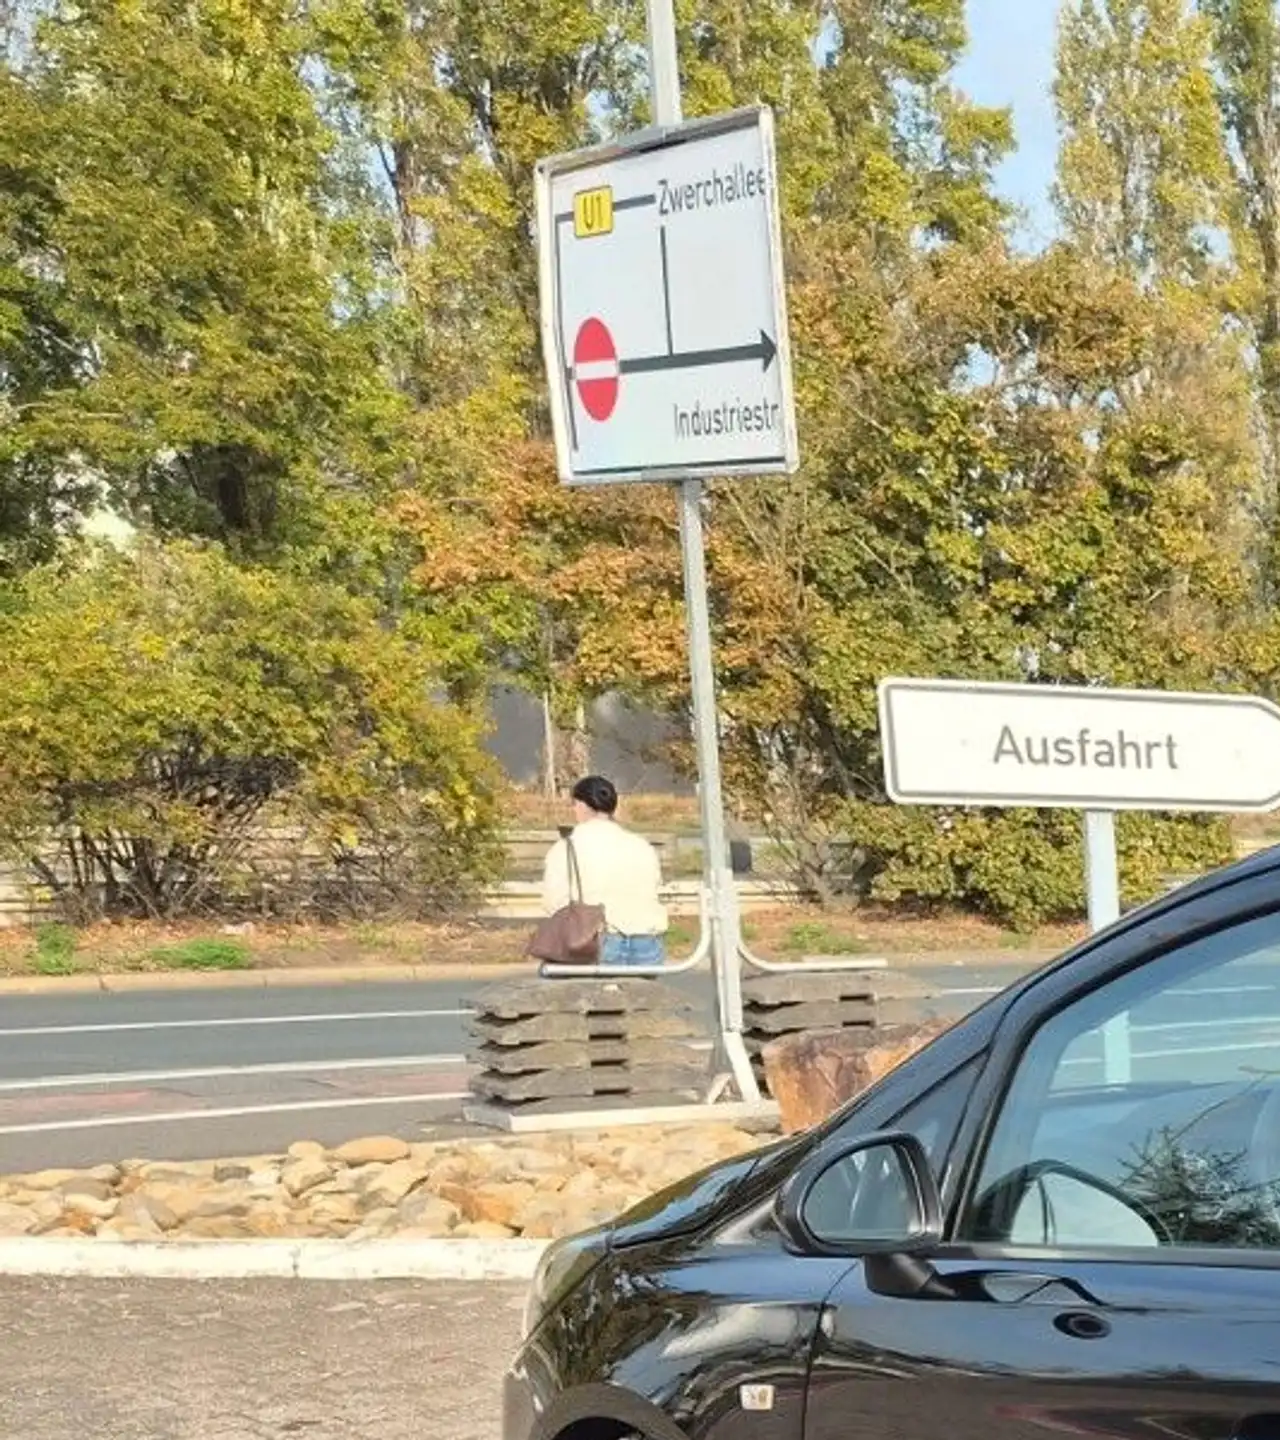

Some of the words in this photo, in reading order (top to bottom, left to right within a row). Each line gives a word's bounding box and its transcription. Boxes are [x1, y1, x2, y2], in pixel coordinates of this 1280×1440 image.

[656, 162, 767, 217] Zwerchallee
[582, 194, 604, 231] U1
[674, 396, 780, 438] Industriestr
[992, 724, 1178, 770] Ausfahrt
